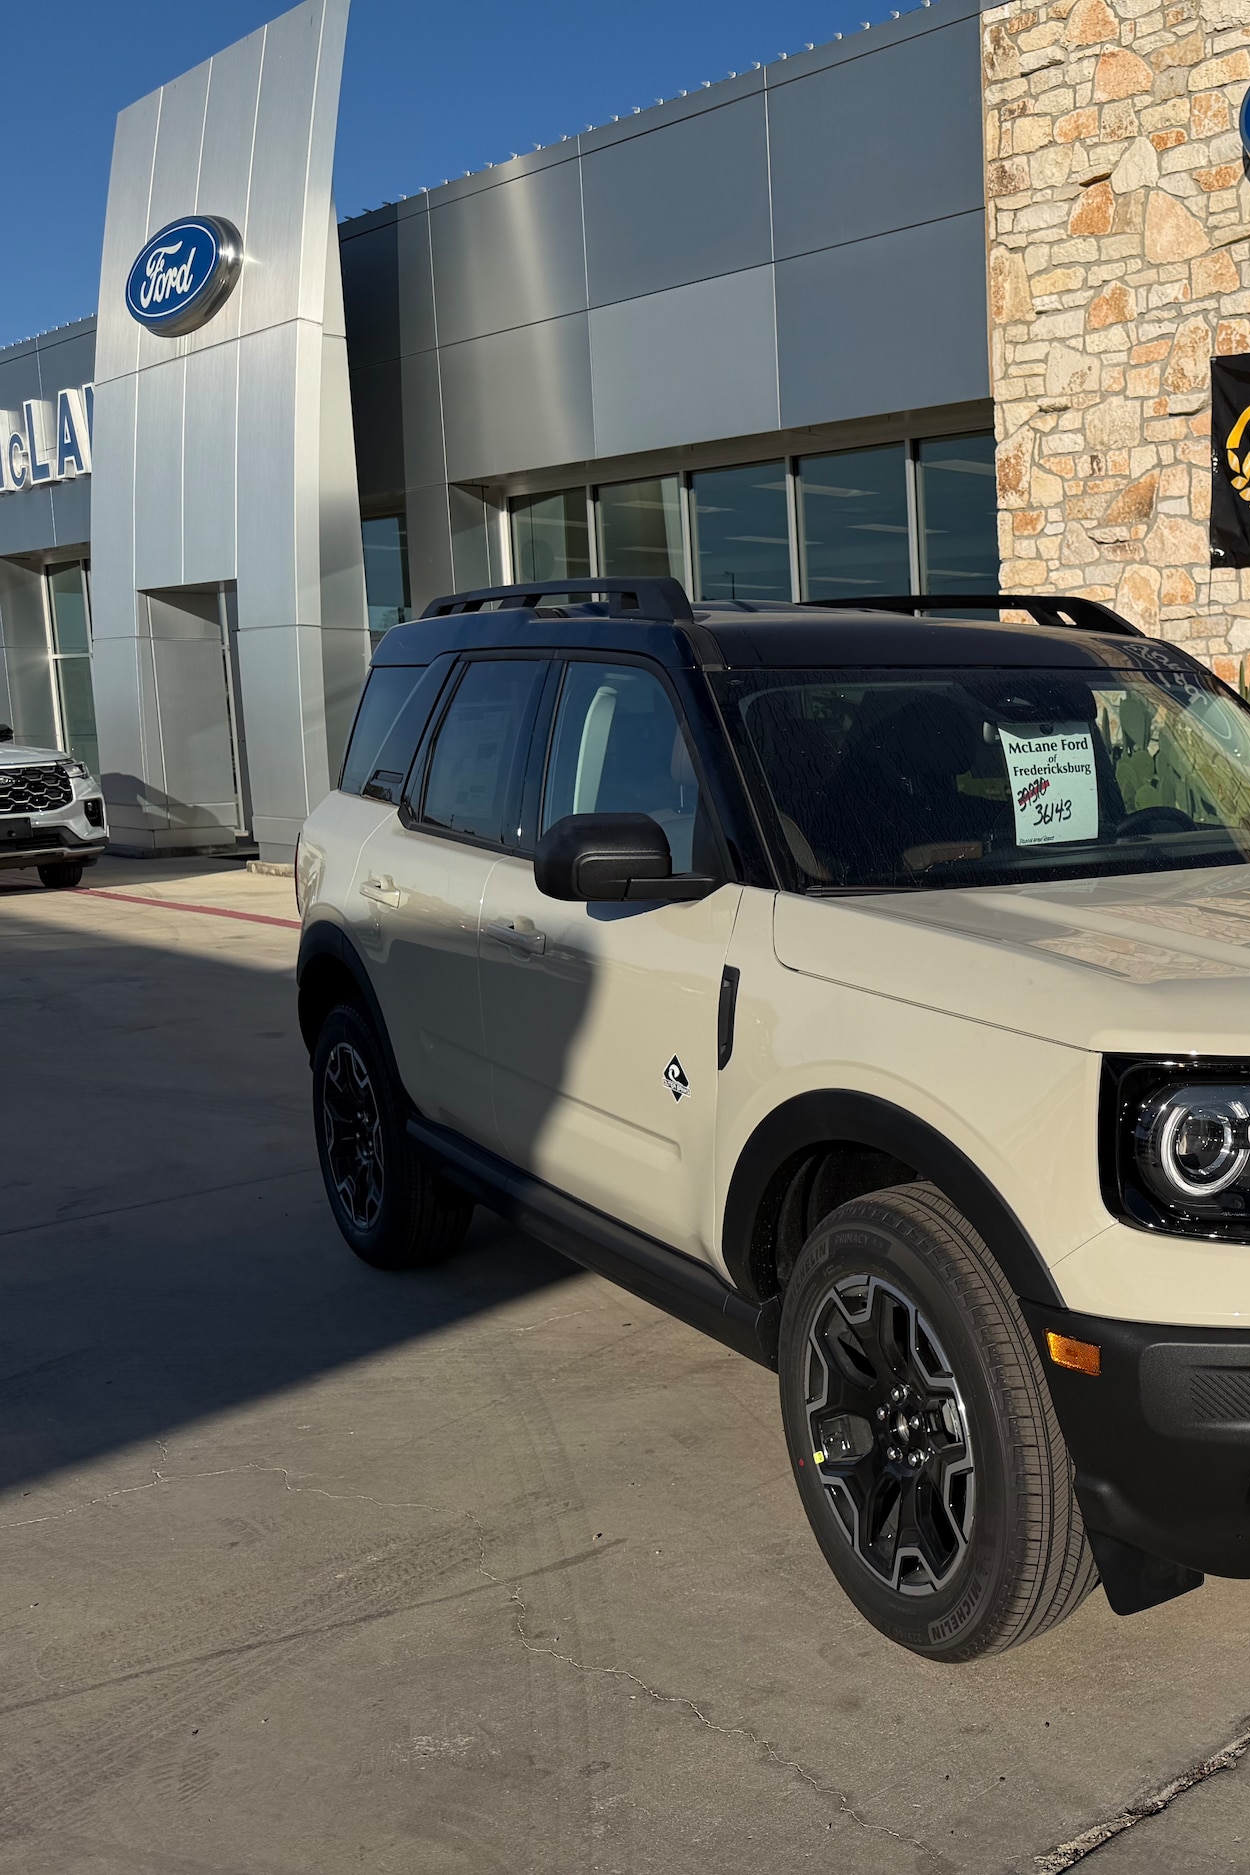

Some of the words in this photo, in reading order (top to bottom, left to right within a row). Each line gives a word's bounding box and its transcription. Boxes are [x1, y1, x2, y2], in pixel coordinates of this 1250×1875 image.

[140, 240, 197, 308] Ford
[1008, 741, 1058, 755] McLane
[1061, 737, 1089, 752] Ford
[1013, 762, 1092, 777] Fredericksburg
[1048, 753, 1058, 763] of
[1033, 798, 1073, 826] 36143
[930, 1579, 982, 1641] MICHELIN
